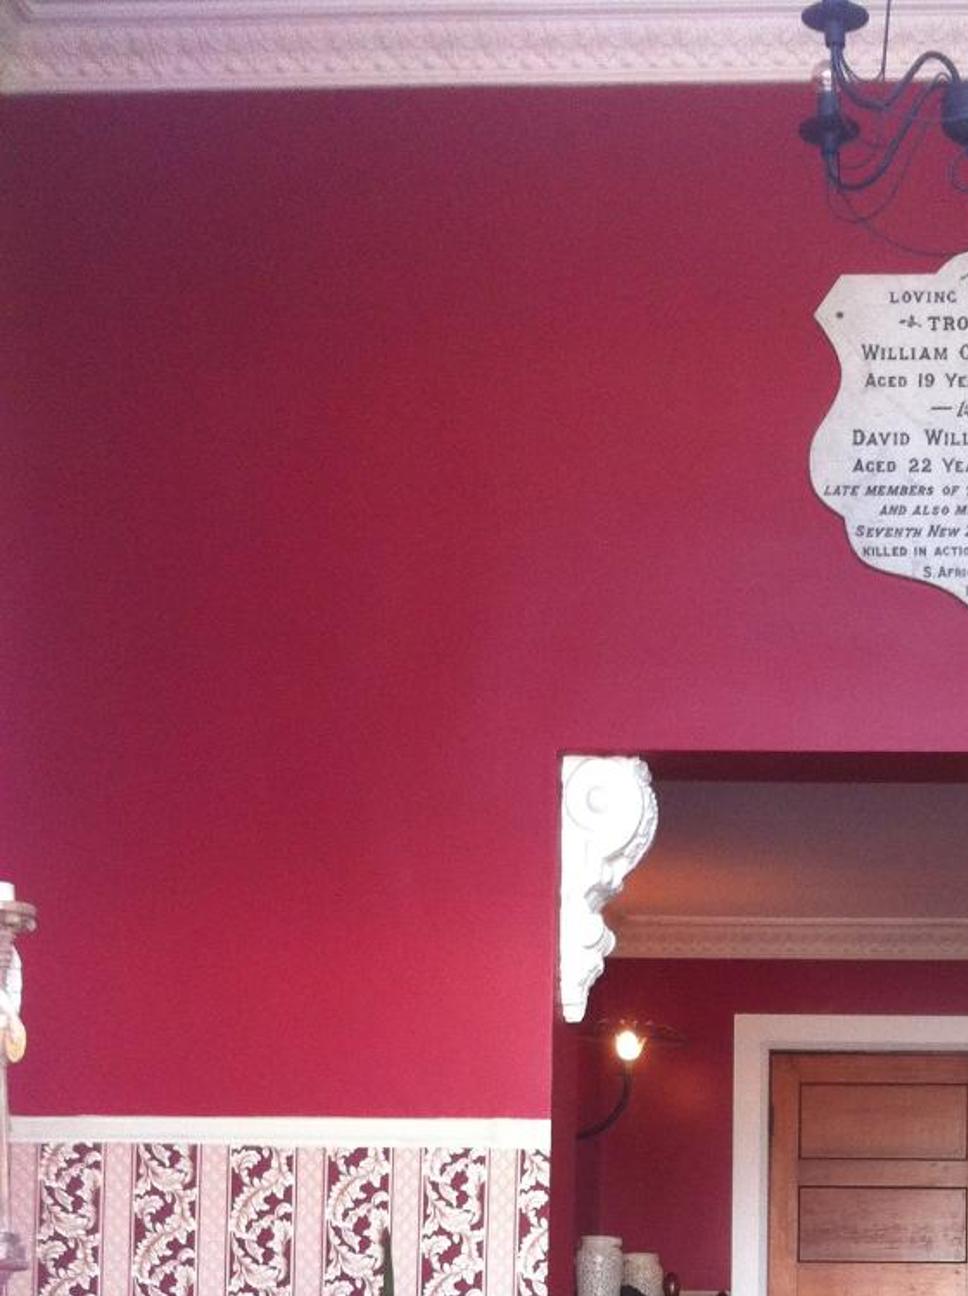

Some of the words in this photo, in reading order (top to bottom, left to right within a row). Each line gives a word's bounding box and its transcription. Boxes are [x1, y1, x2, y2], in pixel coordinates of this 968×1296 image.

[889, 291, 957, 304] LOVING
[861, 344, 948, 361] WILLIAM
[865, 372, 908, 388] AGED
[918, 373, 935, 388] 19
[852, 429, 910, 446] DAVID
[852, 459, 897, 473] AGED
[908, 458, 932, 473] 22
[823, 485, 860, 497] LATE
[864, 485, 934, 497] MEMBERS
[942, 485, 960, 497] OF
[879, 505, 907, 516] AND
[911, 505, 950, 516] ALSO
[855, 525, 922, 538] SEVENTH
[927, 525, 961, 538] NEW
[862, 547, 908, 557] KILLED
[914, 546, 927, 557] IN
